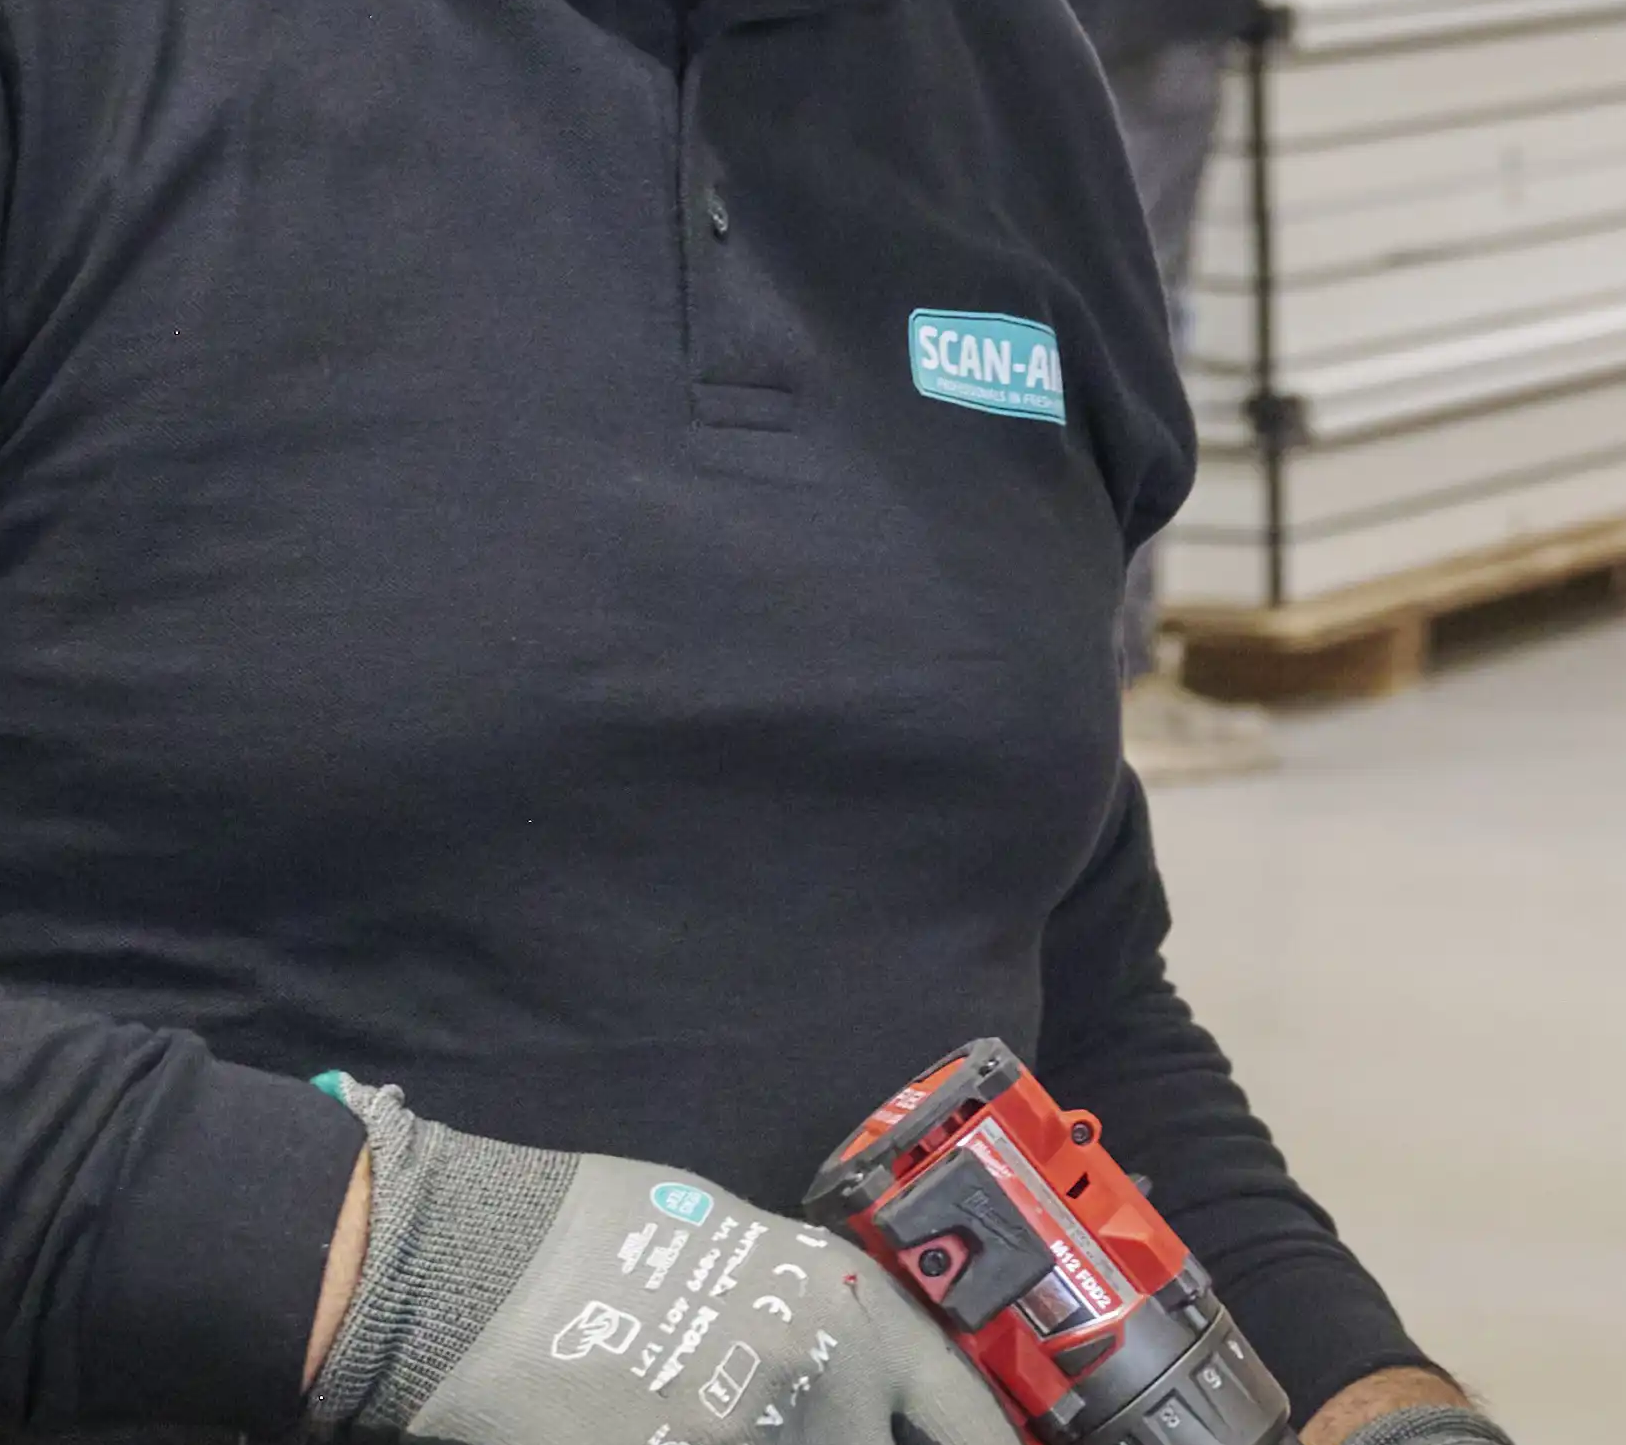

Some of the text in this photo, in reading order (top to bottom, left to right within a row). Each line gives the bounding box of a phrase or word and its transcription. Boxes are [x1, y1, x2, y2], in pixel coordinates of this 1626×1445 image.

[1050, 1240, 1081, 1272] M12
[1075, 1269, 1111, 1309] FDD2
[630, 1340, 664, 1378] 171
[1202, 1366, 1222, 1389] 6
[1160, 1407, 1181, 1428] 8
